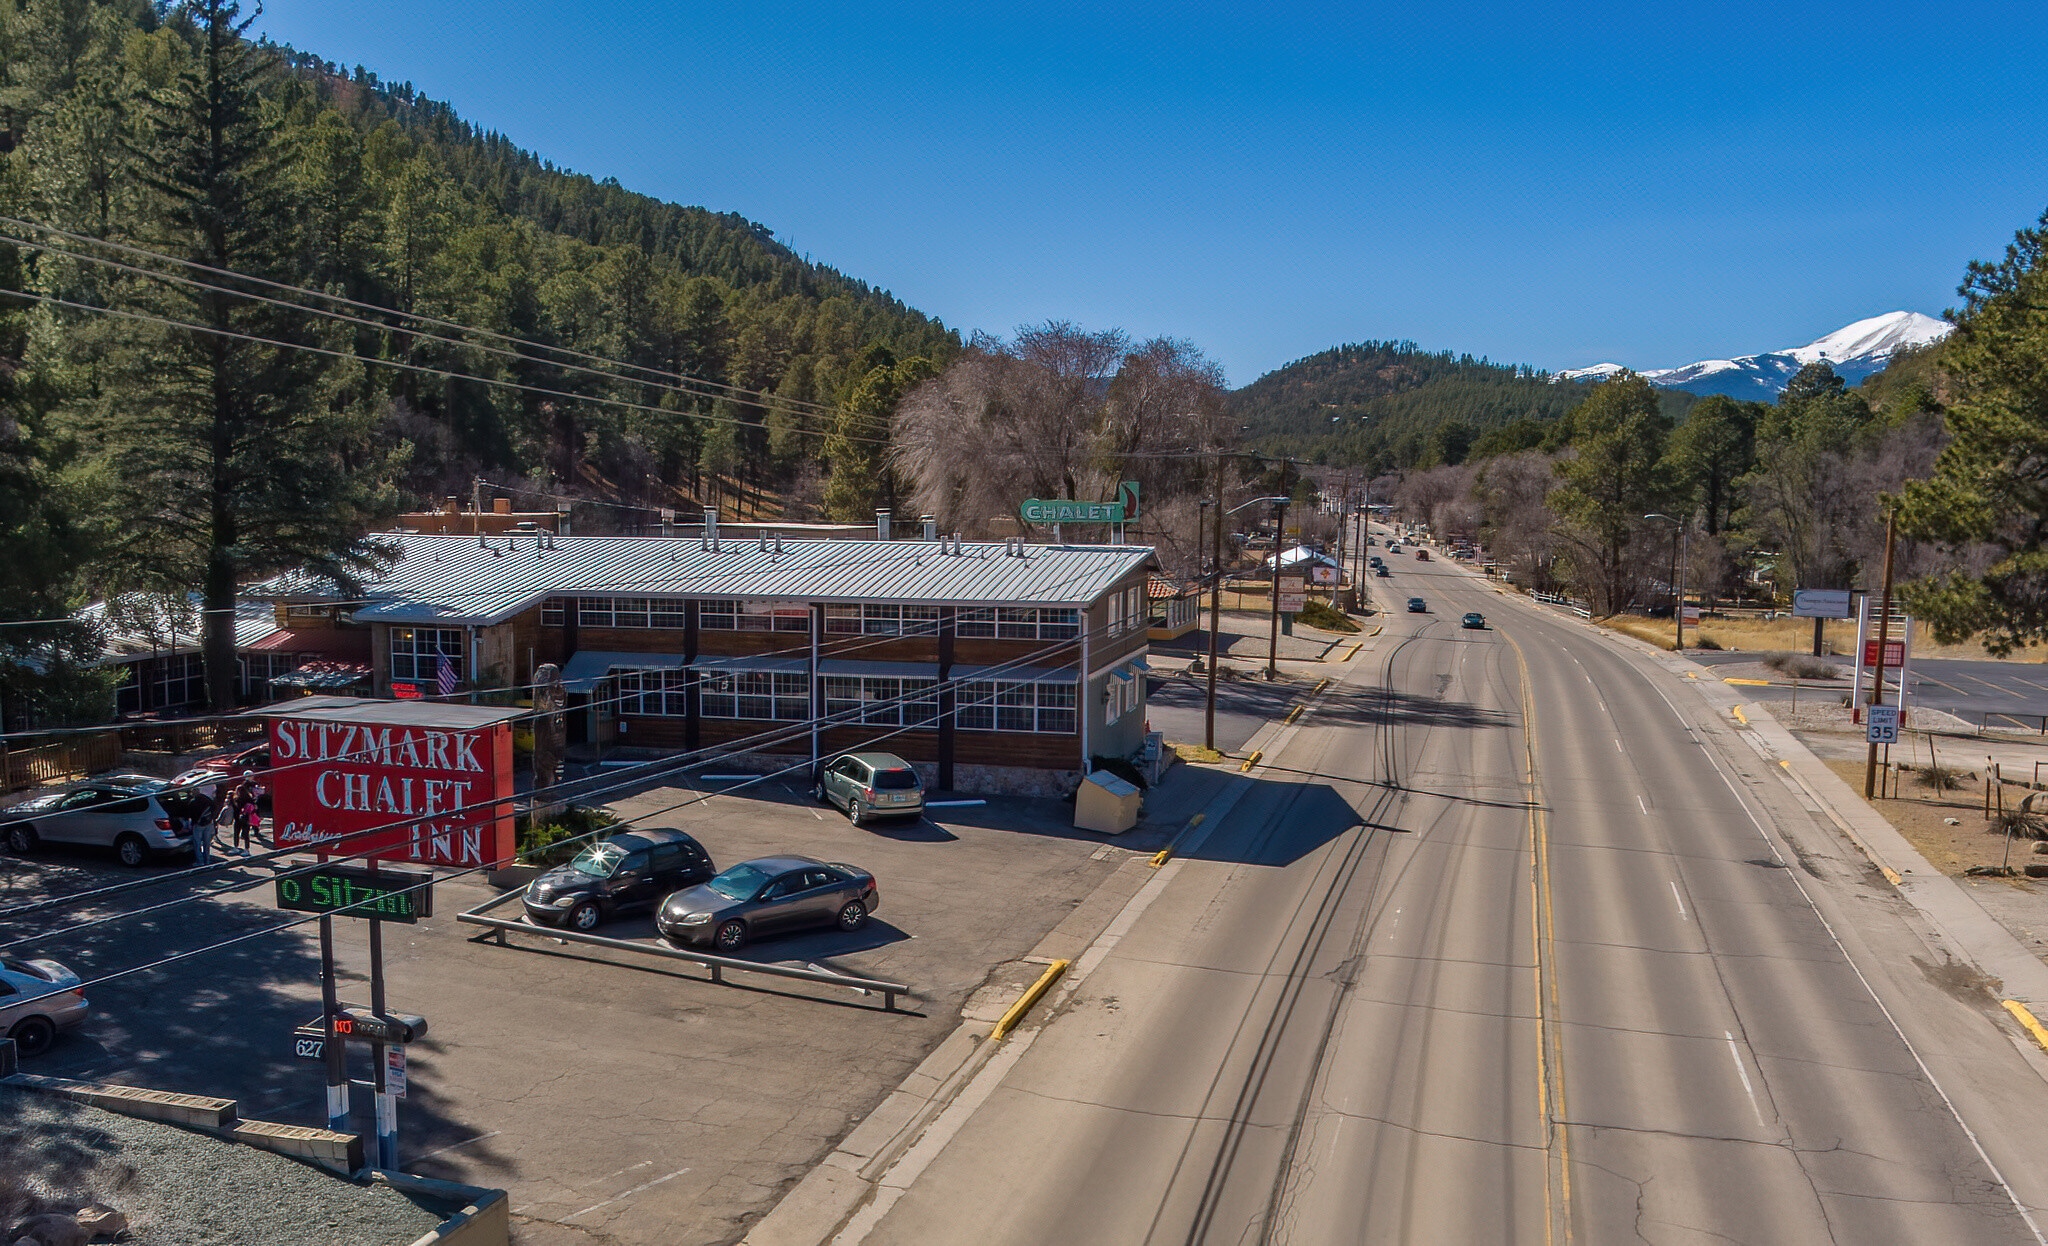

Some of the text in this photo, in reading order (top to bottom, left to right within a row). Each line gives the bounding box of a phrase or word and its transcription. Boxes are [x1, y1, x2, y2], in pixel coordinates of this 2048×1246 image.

[1026, 505, 1115, 520] CHALET
[276, 720, 484, 773] SITZMARK
[1871, 726, 1893, 739] 35
[315, 770, 472, 820] CHALET
[409, 823, 483, 865] INN
[296, 1039, 324, 1058] 627
